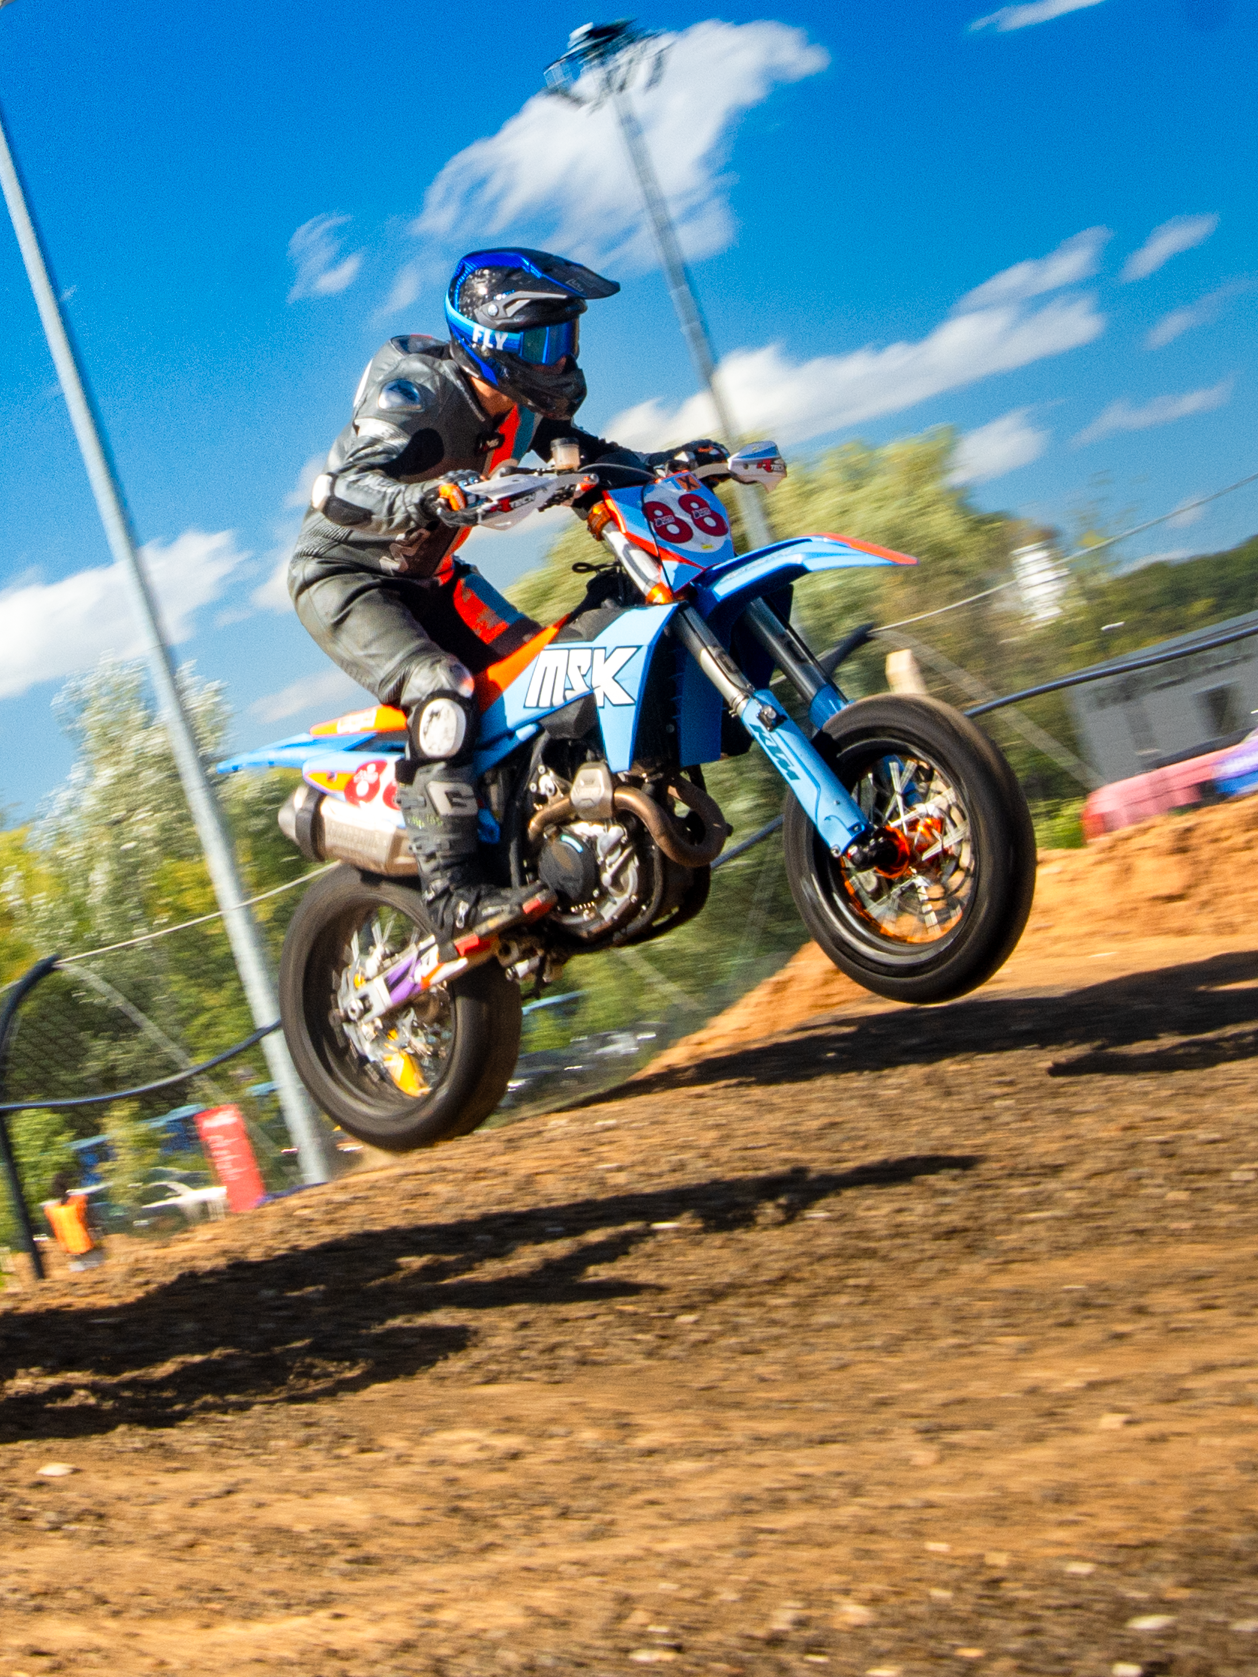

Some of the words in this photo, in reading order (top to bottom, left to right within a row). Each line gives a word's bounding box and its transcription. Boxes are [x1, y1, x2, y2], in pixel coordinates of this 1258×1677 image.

[471, 324, 509, 351] FLY
[642, 493, 729, 544] 88
[524, 645, 641, 709] MSK
[750, 723, 802, 783] KTM
